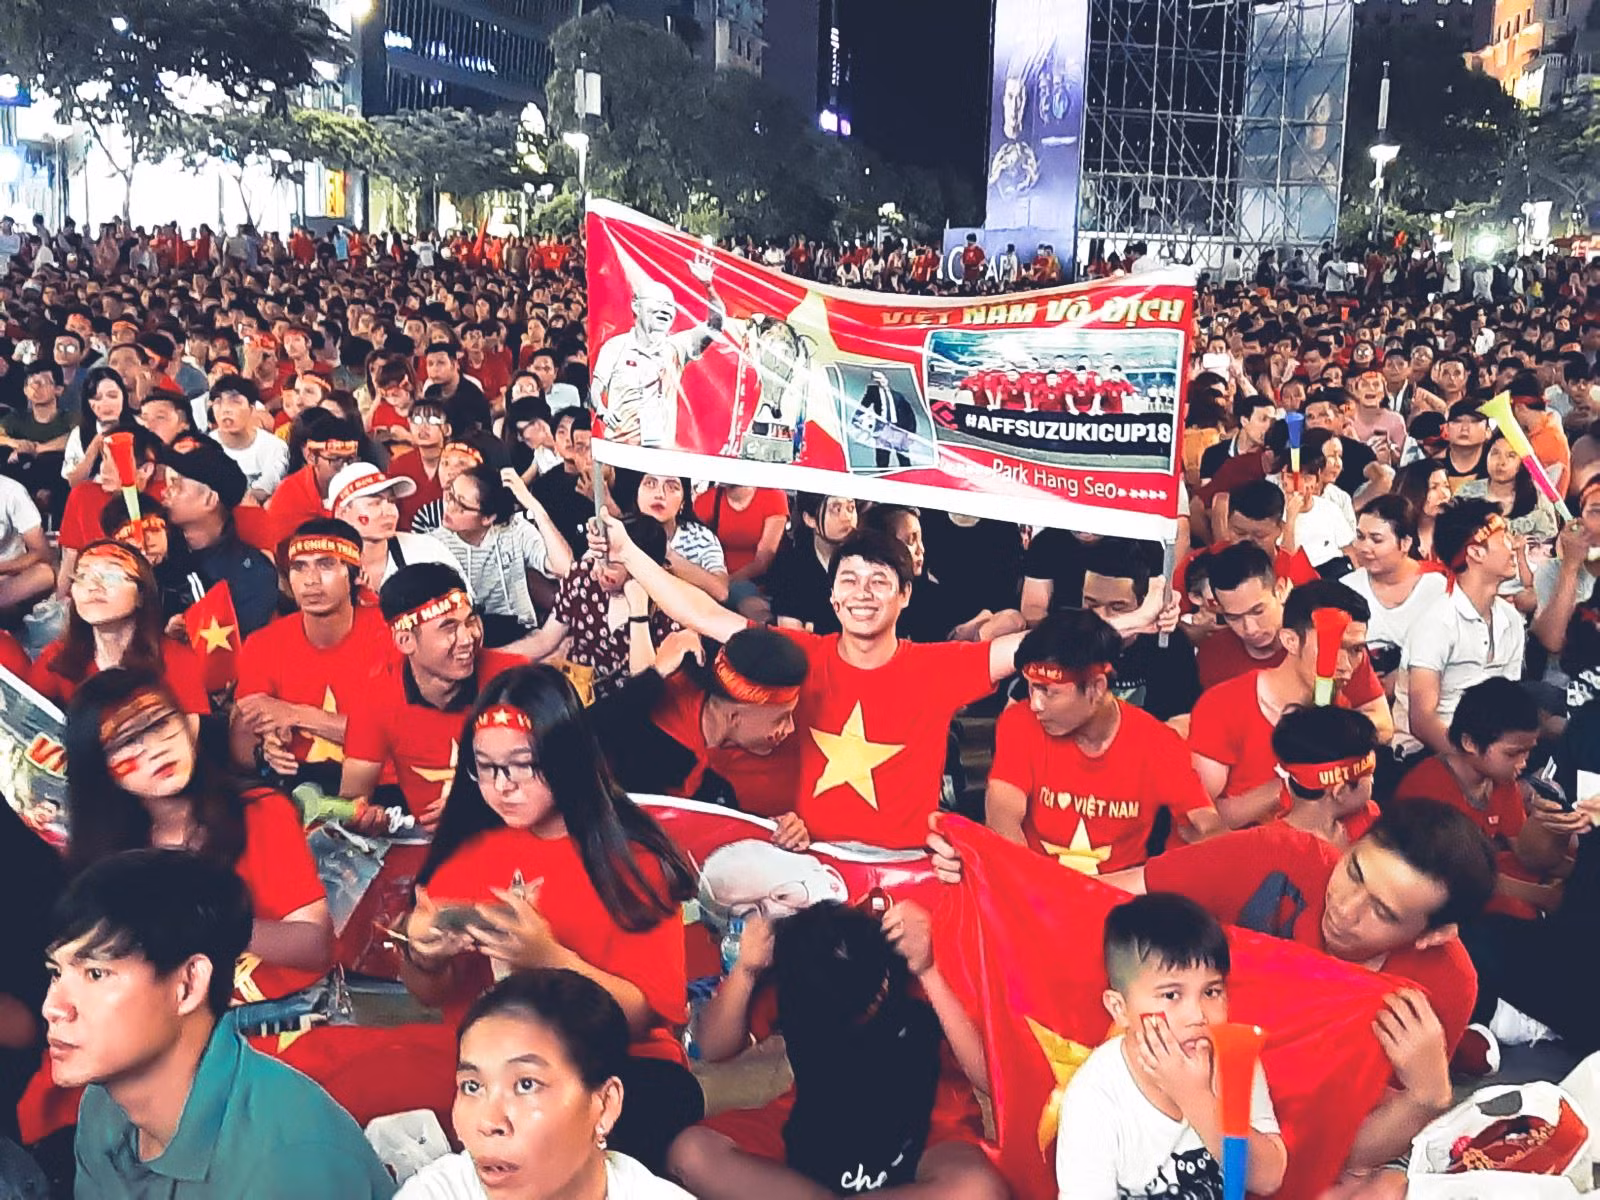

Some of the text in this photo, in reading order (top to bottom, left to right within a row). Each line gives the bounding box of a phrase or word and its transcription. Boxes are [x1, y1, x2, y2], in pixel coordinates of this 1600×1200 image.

[961, 303, 1037, 325] NAM
[1044, 295, 1091, 323] VÔ
[1100, 297, 1186, 328] ĐỊCH
[965, 413, 1172, 443] #AFFSUZUKICUP18
[991, 458, 1029, 485] Park
[1034, 468, 1079, 497] Hang
[1084, 476, 1116, 499] Seo
[420, 598, 451, 621] NAM
[1074, 794, 1106, 820] VIỆT
[1108, 801, 1140, 819] NAM
